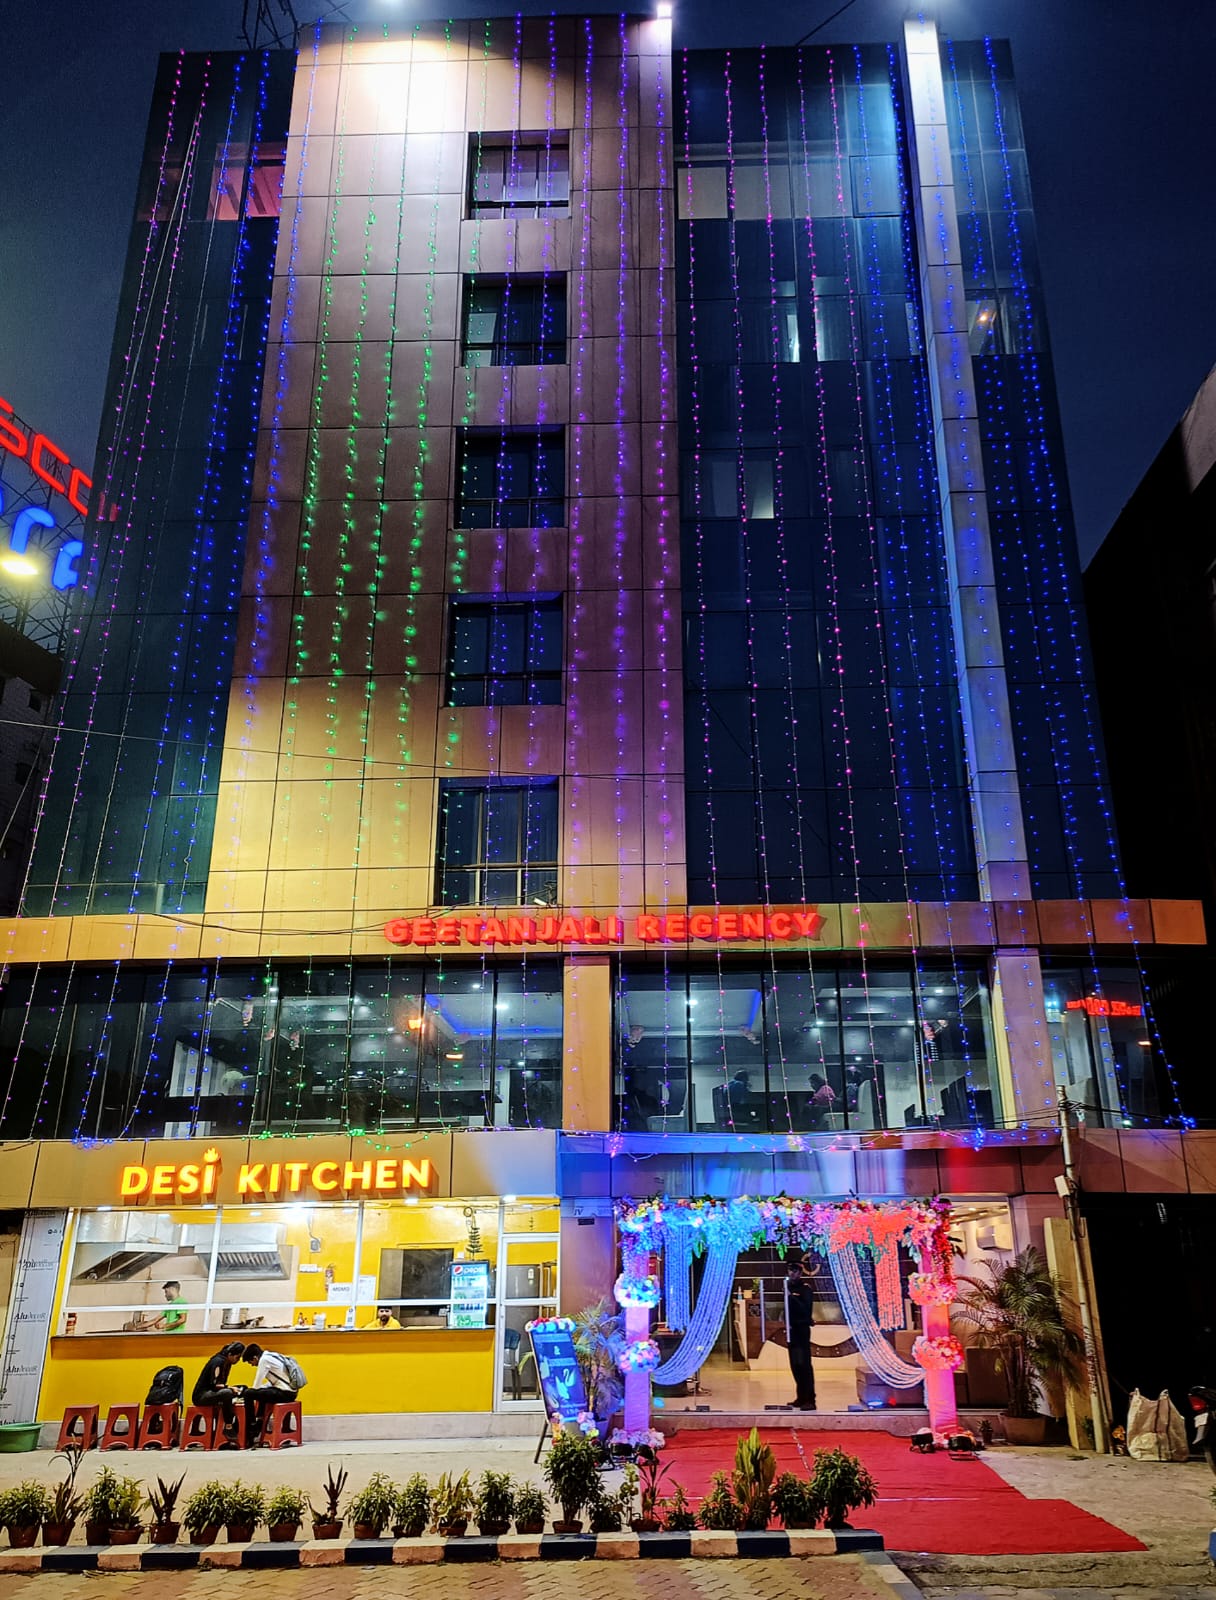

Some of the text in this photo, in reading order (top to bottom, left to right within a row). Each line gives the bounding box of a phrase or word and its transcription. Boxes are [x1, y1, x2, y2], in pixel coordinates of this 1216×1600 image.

[383, 912, 818, 945] GEETANJALI REGENCY
[238, 1159, 431, 1195] KITCHEN
